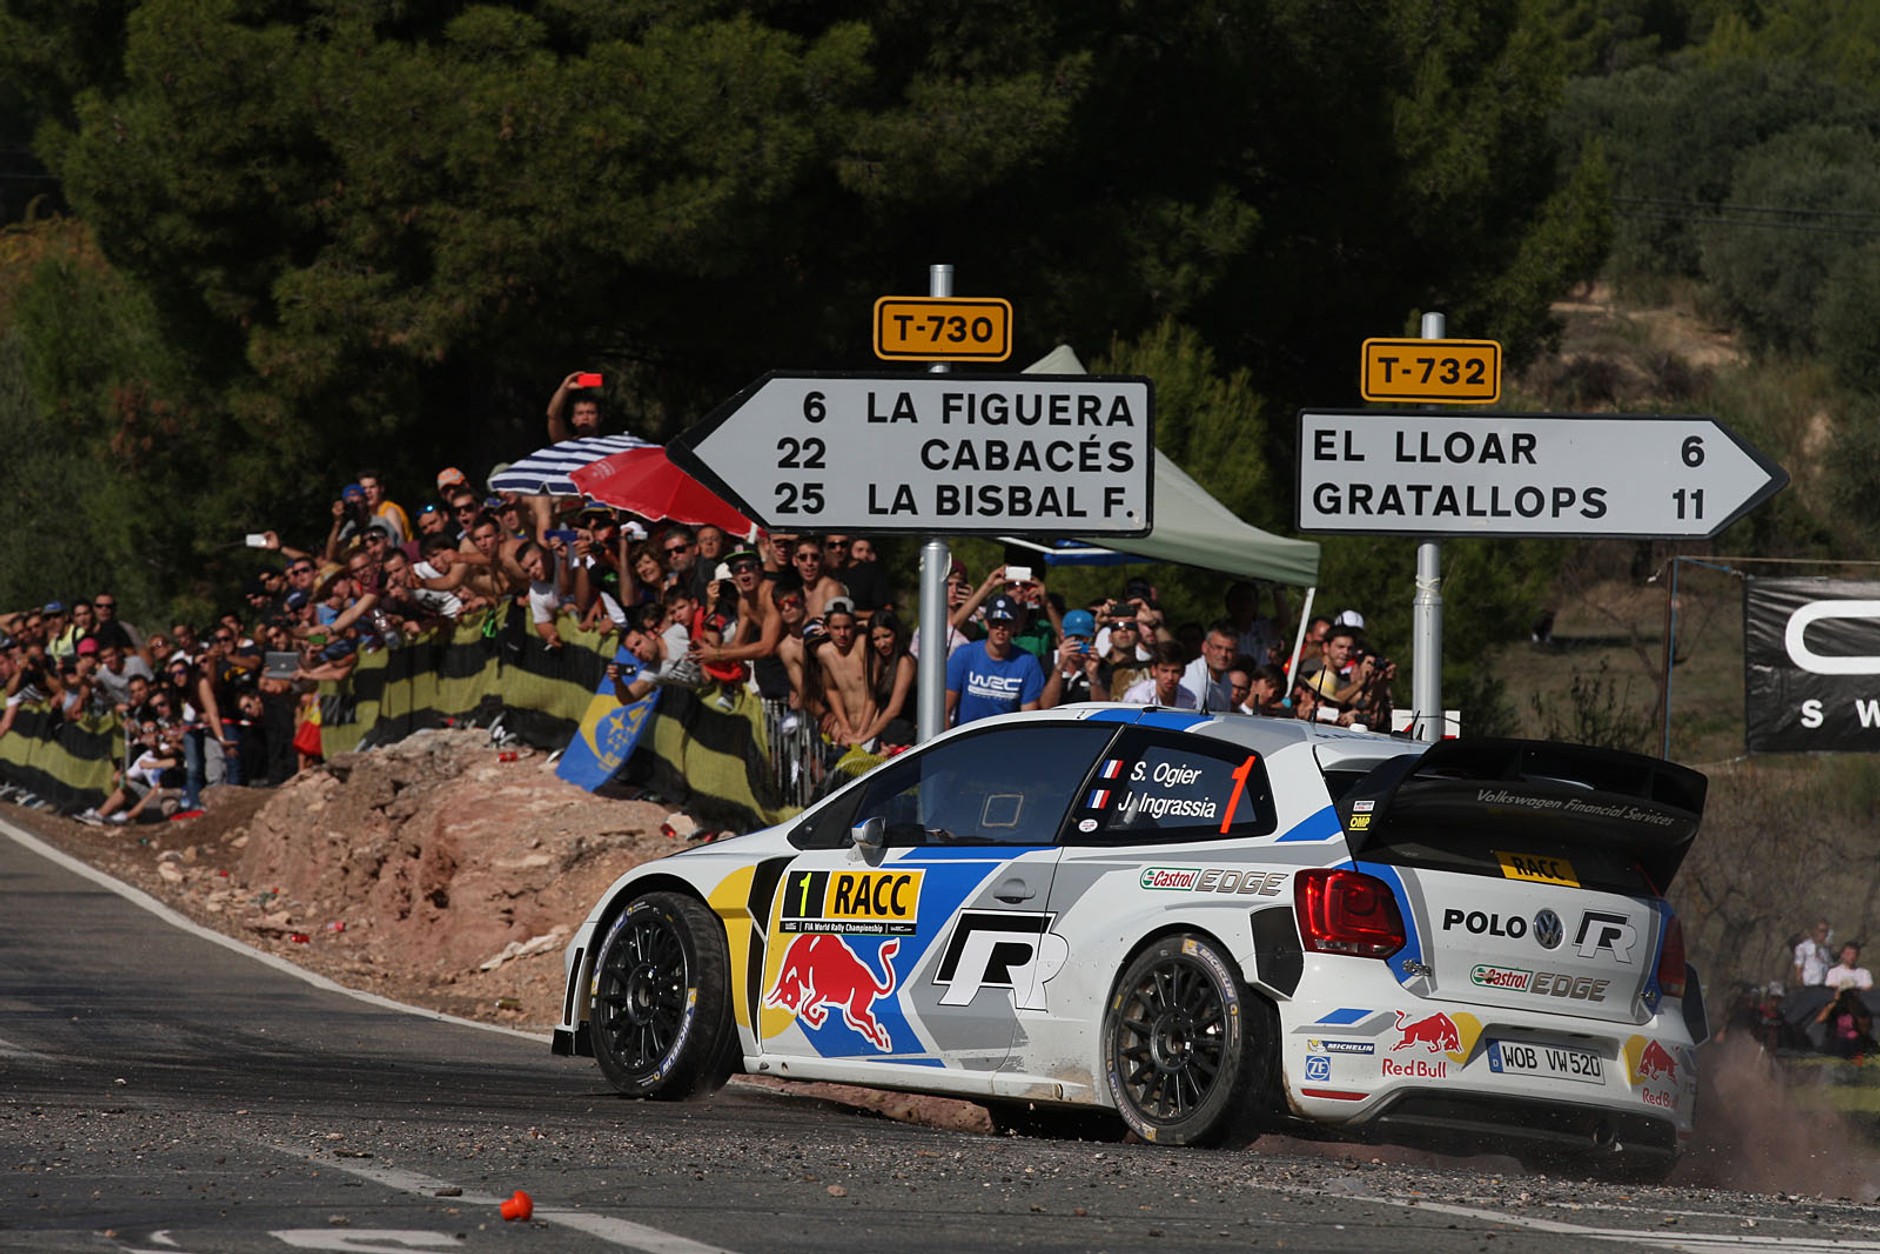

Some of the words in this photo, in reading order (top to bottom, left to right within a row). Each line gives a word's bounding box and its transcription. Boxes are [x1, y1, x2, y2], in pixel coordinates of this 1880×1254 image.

[893, 314, 994, 342] T-730
[1377, 356, 1486, 385] T-732
[802, 391, 827, 424] 6
[867, 392, 918, 424] LA
[941, 393, 1134, 427] FIGUERA
[776, 437, 826, 470] 22
[920, 434, 1135, 473] CABACÉS
[1313, 429, 1366, 462] EL
[1396, 431, 1537, 464] LLOAR
[1680, 435, 1705, 468] 6
[774, 483, 825, 515] 25
[868, 483, 919, 516] LA
[935, 485, 1087, 518] BISBAL
[1103, 487, 1135, 519] F.
[1312, 482, 1608, 519] GRATALLOPS
[1671, 489, 1704, 520] 11
[969, 671, 1023, 691] WRC
[1130, 761, 1147, 782] S.
[1152, 762, 1202, 787] Ogier
[1117, 791, 1134, 812] J.
[1138, 792, 1217, 819] Ingrassia
[1219, 755, 1257, 834] 1
[1476, 789, 1563, 809] Volkswagen
[1564, 798, 1628, 818] Financial
[1624, 807, 1675, 827] Services
[1350, 816, 1371, 828] OMP
[1153, 870, 1196, 887] Castrol
[1195, 868, 1290, 897] EDGE
[1511, 856, 1566, 880] RACC
[799, 872, 812, 917] 1
[833, 874, 912, 916] RACC
[1443, 908, 1527, 939] POLO
[931, 907, 1070, 1014] R
[1529, 971, 1610, 1002] EDGE
[1326, 1043, 1374, 1052] MICHELIN
[1502, 1045, 1538, 1069] WOB
[1545, 1050, 1569, 1072] VW
[1569, 1052, 1602, 1077] 520
[1310, 1061, 1327, 1077] ZF
[1382, 1058, 1415, 1077] Red
[1416, 1061, 1447, 1078] Bull
[1642, 1087, 1662, 1104] Red
